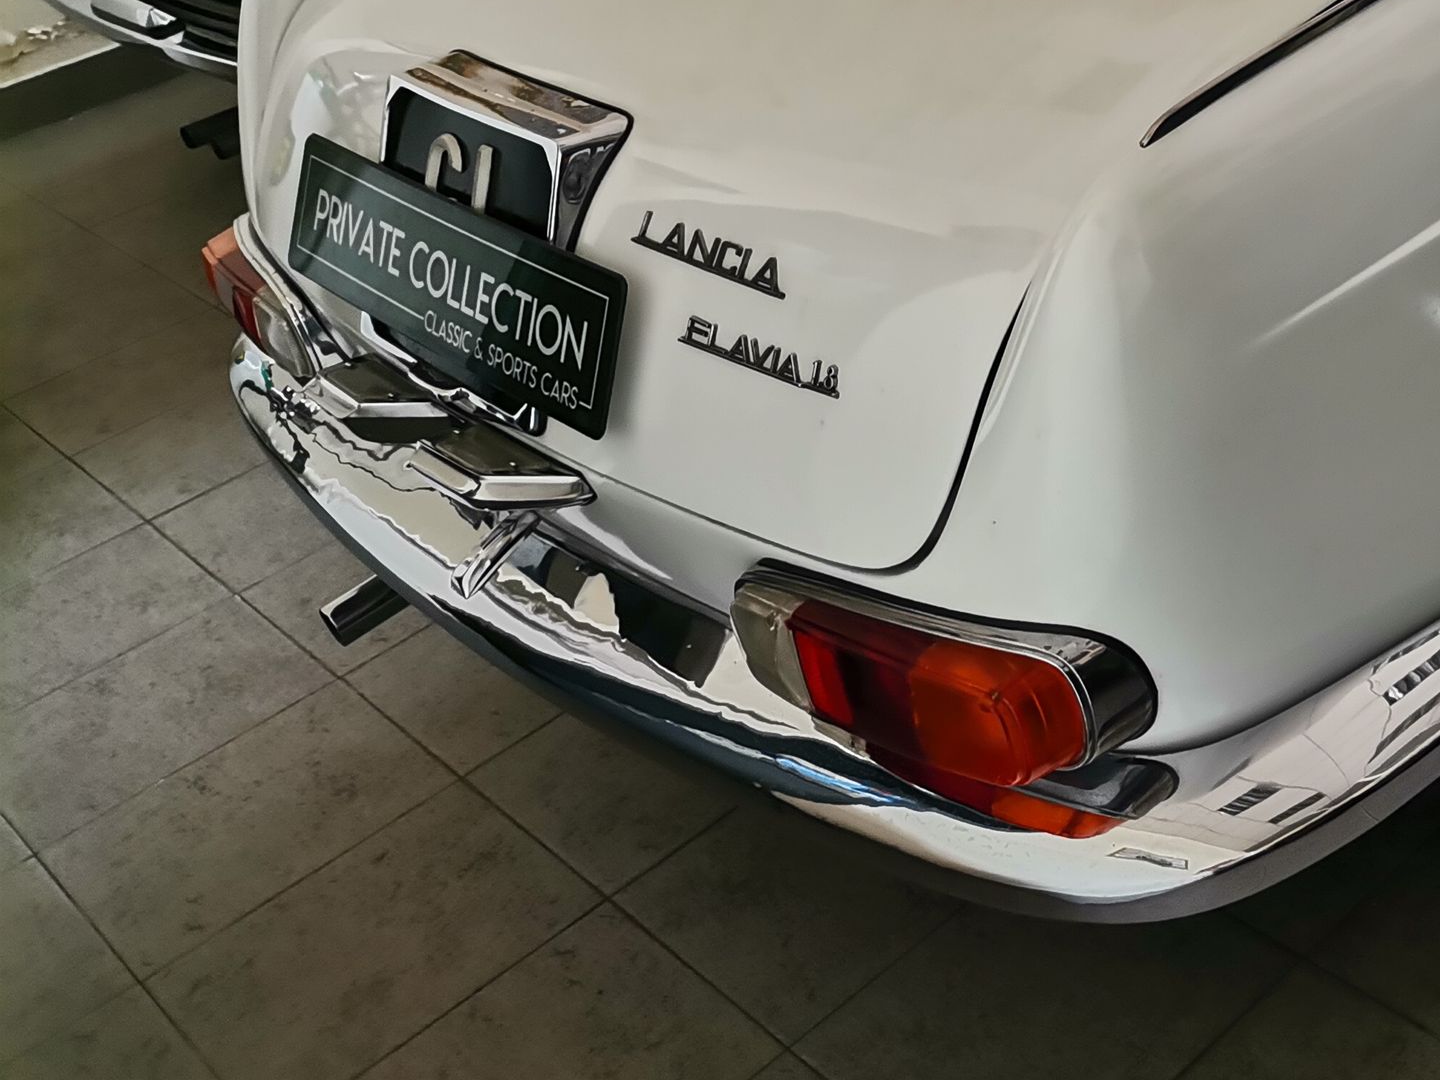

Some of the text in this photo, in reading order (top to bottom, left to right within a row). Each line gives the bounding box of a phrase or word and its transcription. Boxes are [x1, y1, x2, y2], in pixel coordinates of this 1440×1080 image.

[313, 188, 588, 370] PRIVATE COLLECTION
[631, 210, 785, 300] LANCIA
[424, 310, 578, 410] CLASSIC & SPORTS CARS
[680, 315, 802, 387] FLAVIA
